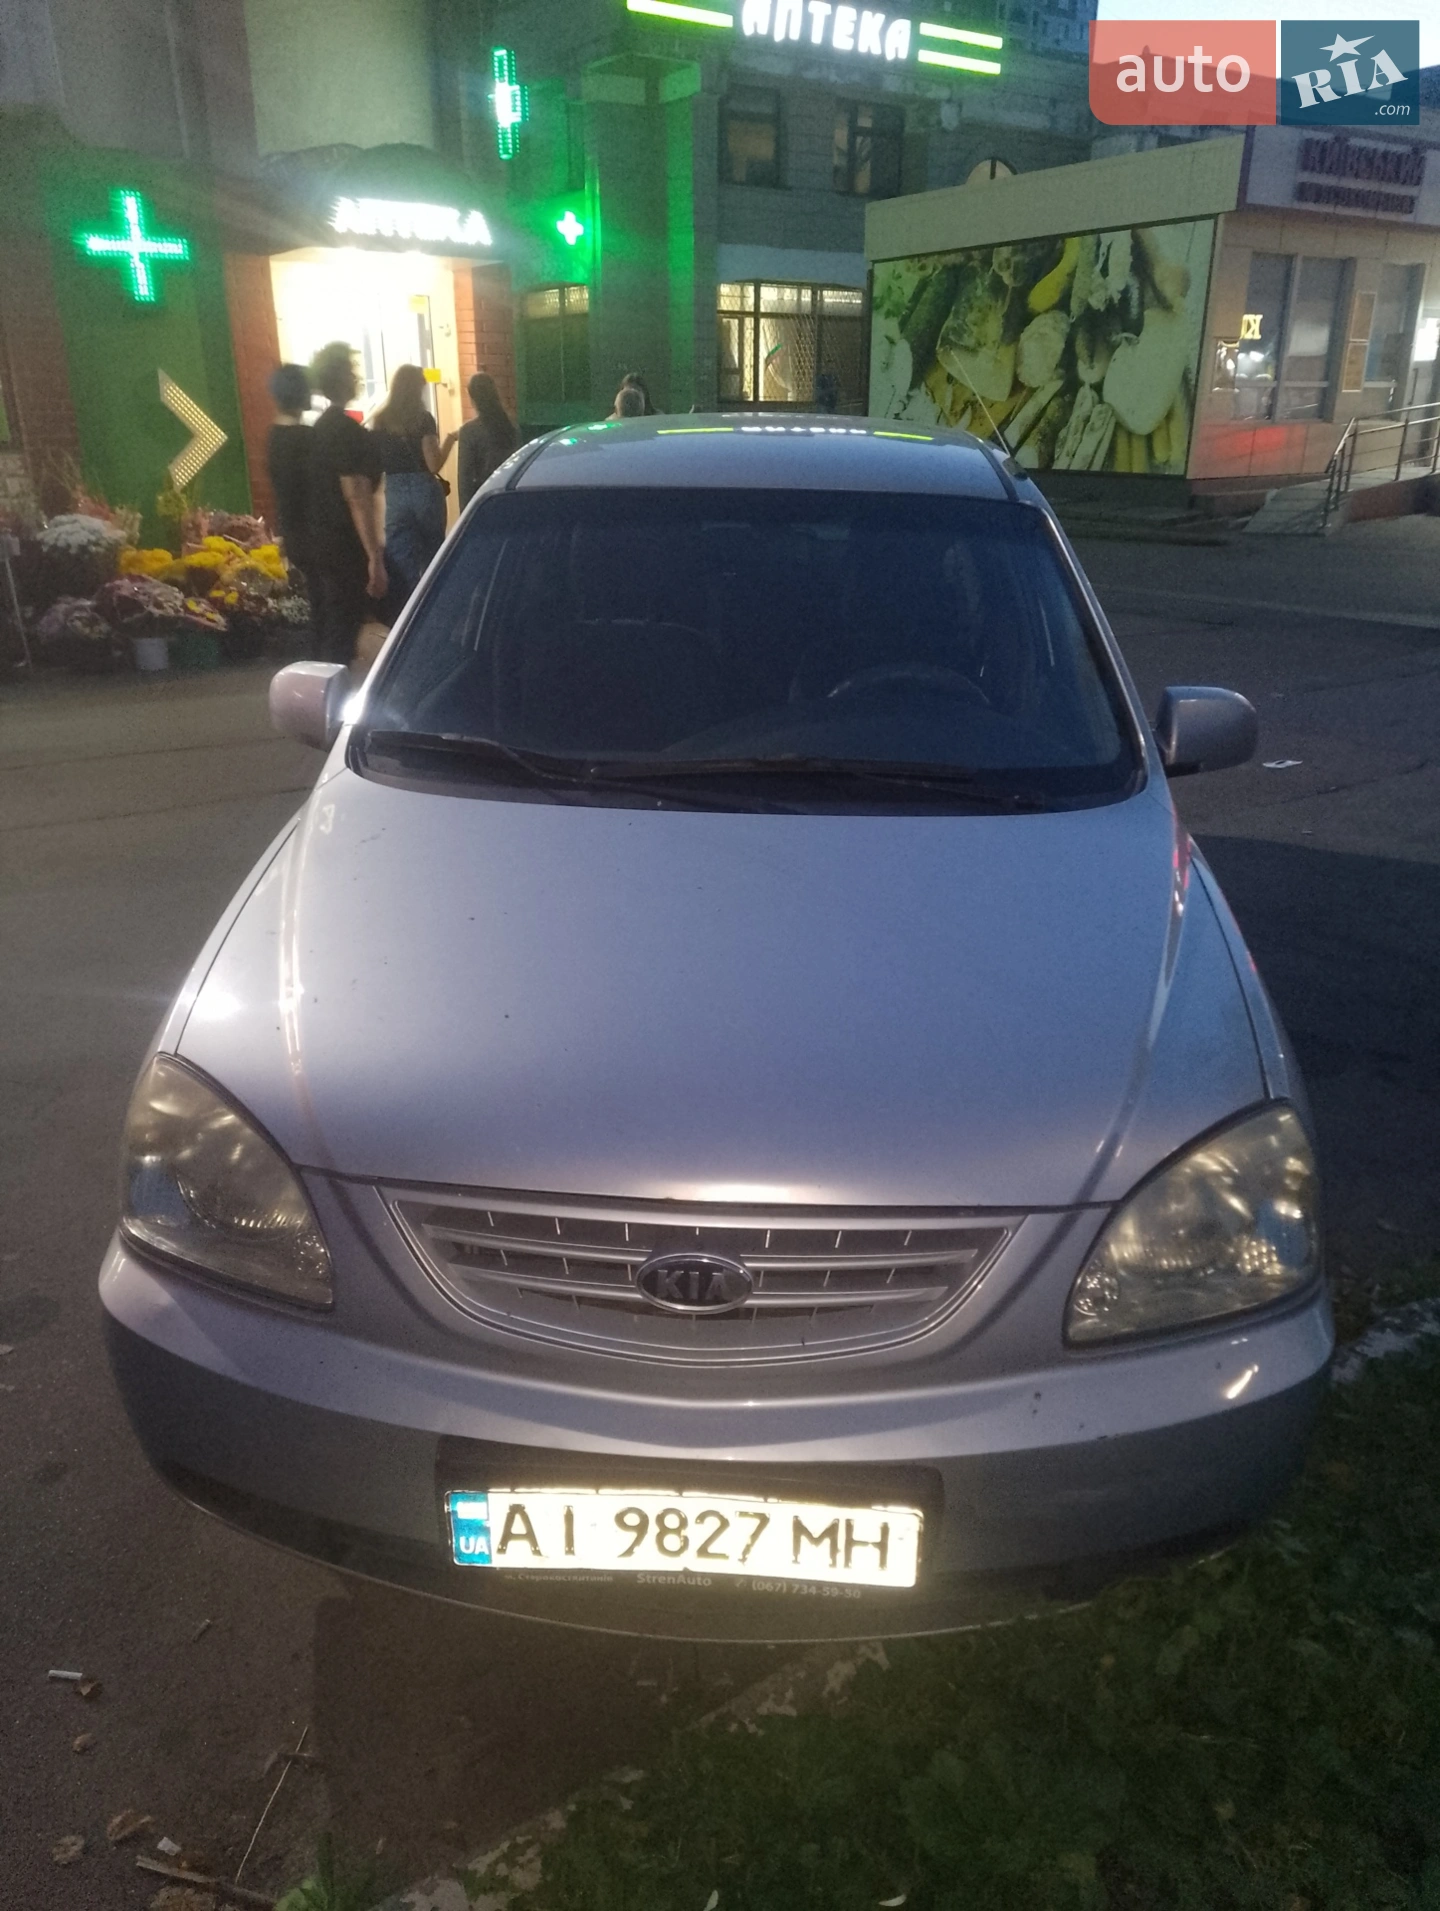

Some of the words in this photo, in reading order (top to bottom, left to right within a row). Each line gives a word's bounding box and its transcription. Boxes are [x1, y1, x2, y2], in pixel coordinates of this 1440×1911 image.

[742, 0, 911, 60] АПТЕКА
[657, 1269, 729, 1300] KIA
[459, 1536, 490, 1555] UA
[497, 1503, 575, 1557] AI
[614, 1506, 770, 1566] 9827
[792, 1515, 889, 1570] MH
[636, 1572, 713, 1588] StrenAuto
